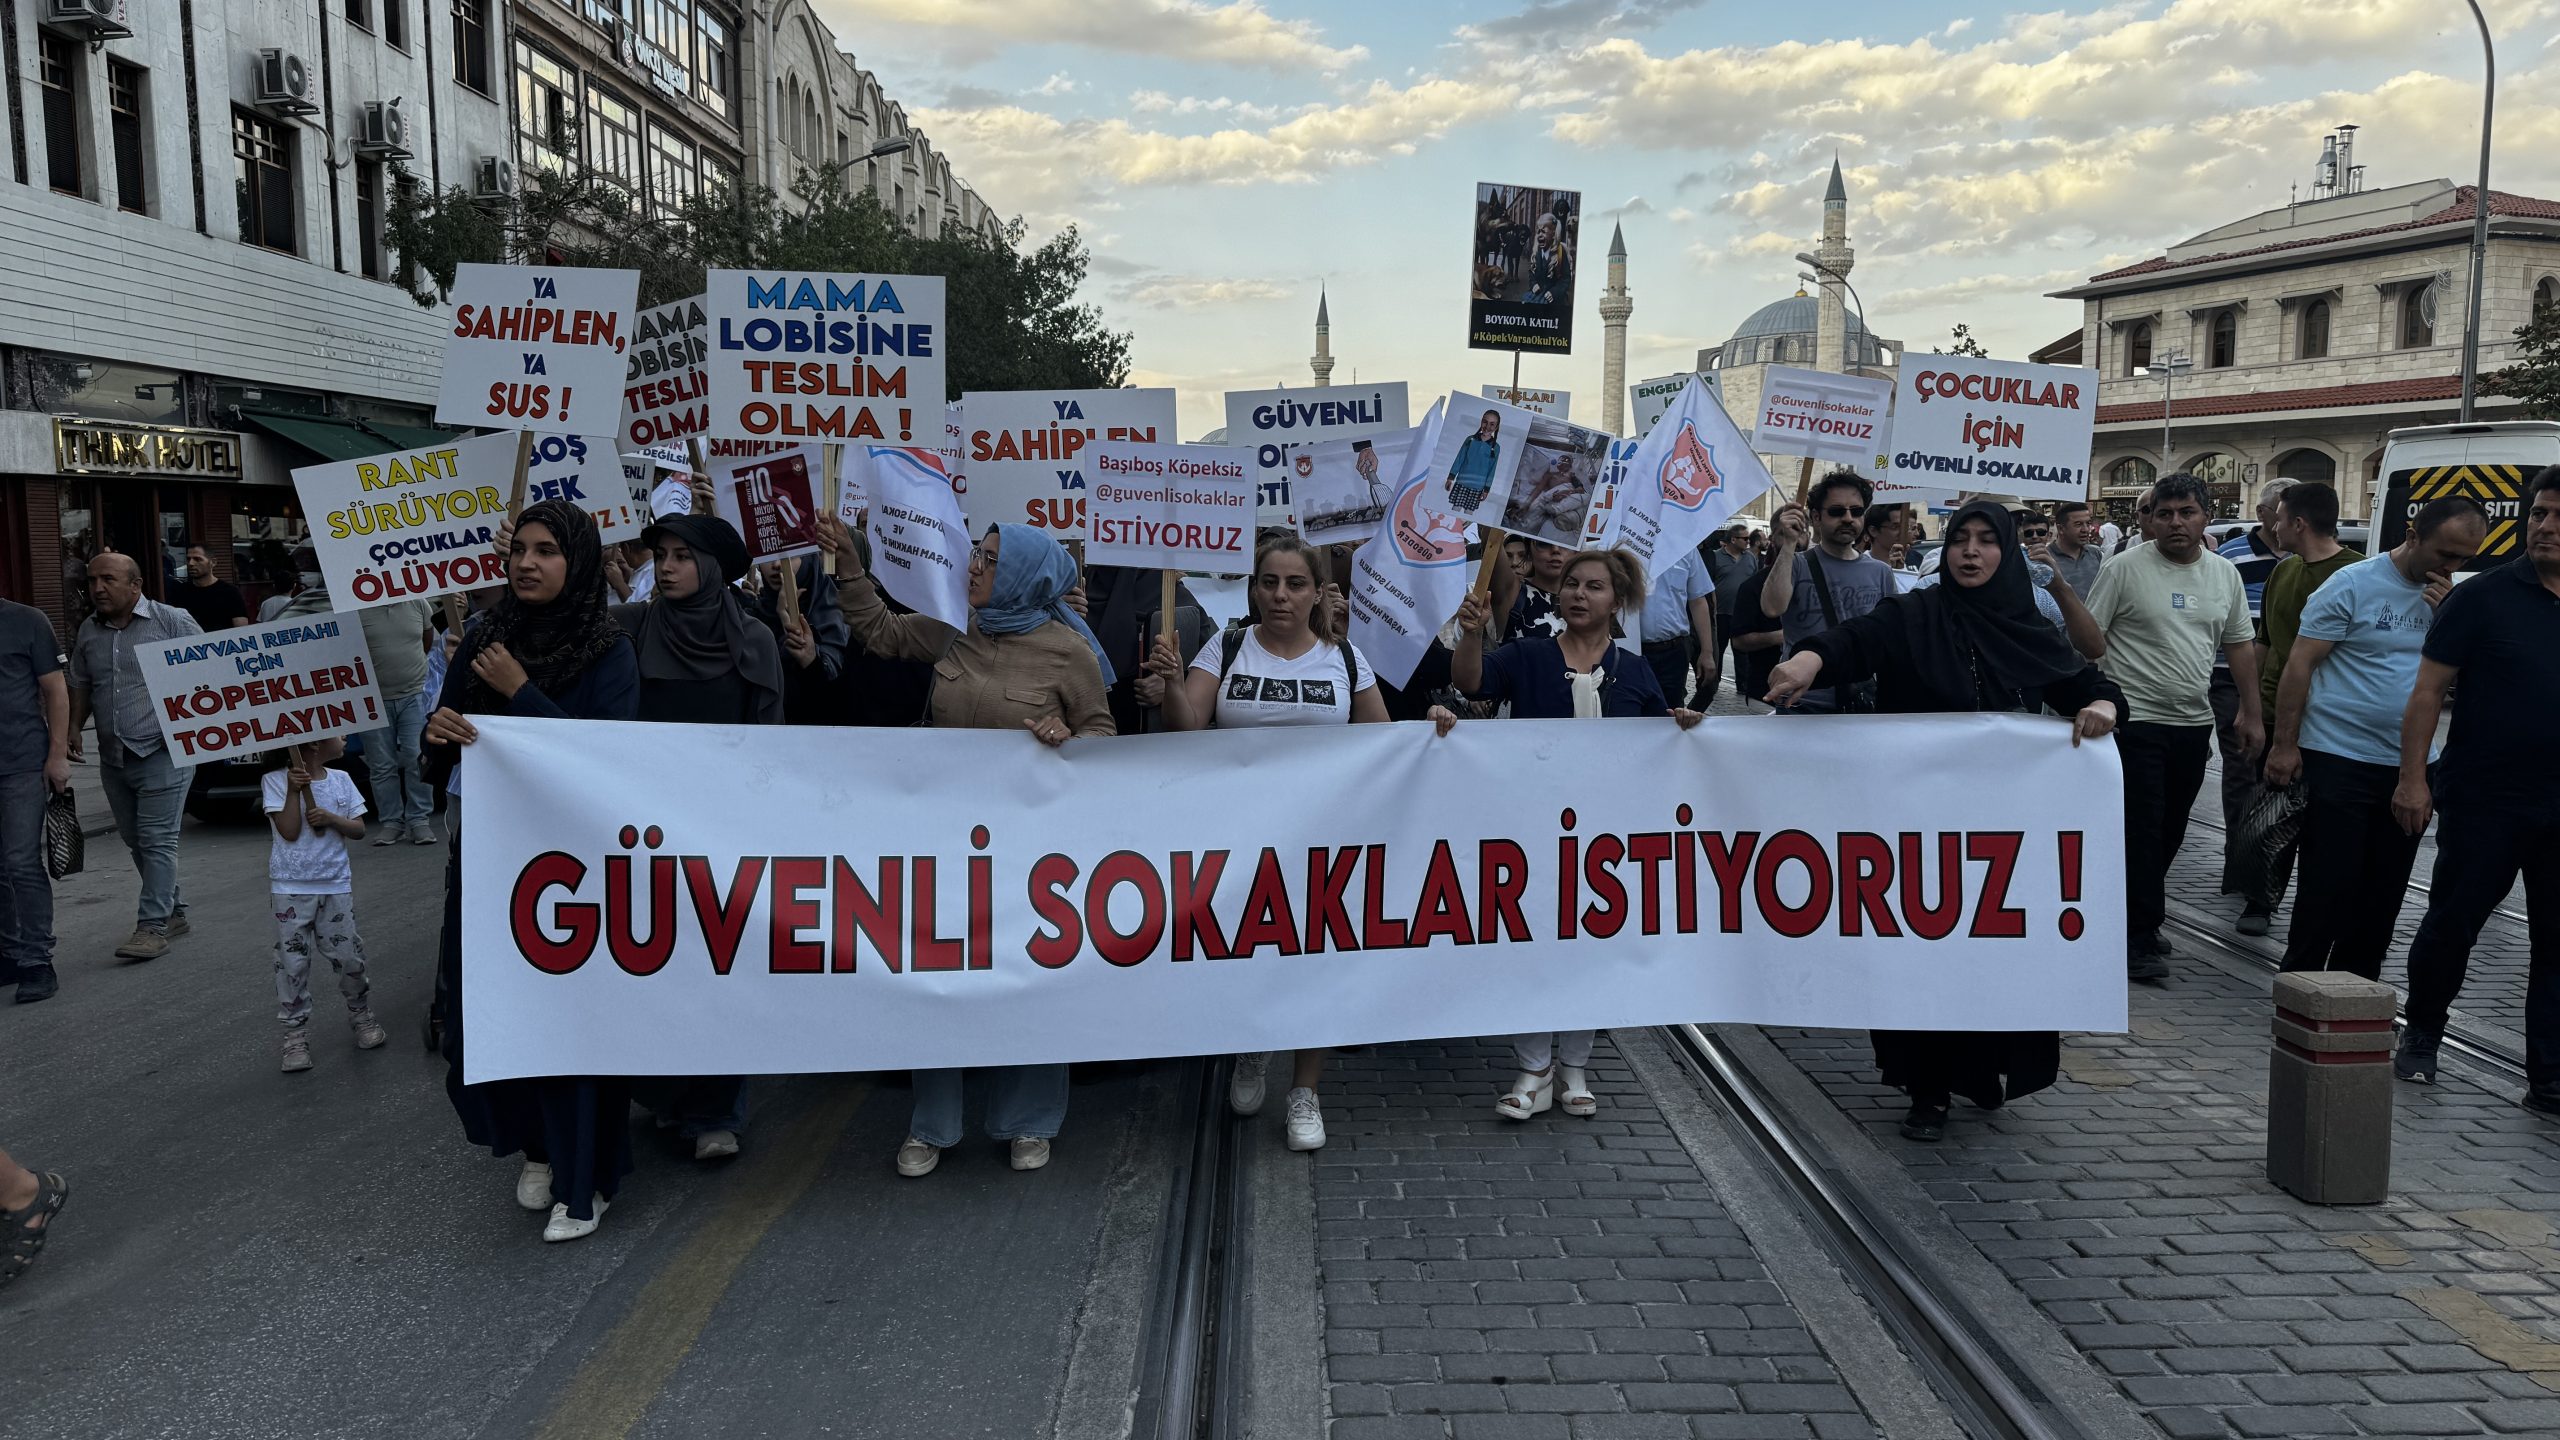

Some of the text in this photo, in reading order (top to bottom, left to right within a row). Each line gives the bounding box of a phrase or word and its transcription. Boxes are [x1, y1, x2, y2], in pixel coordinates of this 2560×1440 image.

[118, 0, 126, 21] VES
[533, 277, 557, 299] YA
[748, 276, 904, 313] MAMA
[454, 299, 626, 354] SAHİPLEN,
[631, 302, 708, 345] AMA
[720, 313, 932, 357] LOBİSİNE
[1485, 314, 1559, 330] BOYKOTA KATIL!
[523, 353, 547, 375] YA
[627, 333, 708, 381] OBİSİN
[743, 356, 906, 398] TESLİM
[1915, 370, 2080, 409] ÇOCUKLAR
[486, 382, 572, 422] SUS !
[740, 401, 912, 441] OLMA !
[1053, 400, 1084, 420] YA
[1252, 392, 1383, 430] GÜVENLİ
[1771, 394, 1875, 417] @Guvenlisokaklar
[1764, 407, 1873, 439] İSTİYORUZ
[1962, 412, 2024, 453] İÇİN
[63, 429, 239, 472] THINK HOTEL
[356, 449, 459, 491] RANT
[1099, 454, 1243, 478] Başıboş Köpeksiz
[1895, 451, 1973, 475] GÜVENLİ
[1976, 460, 2072, 484] SOKAKLAR
[2076, 469, 2083, 485] !
[1056, 470, 1086, 490] YA
[1096, 483, 1246, 507] @guvenlisokaklar
[2482, 501, 2520, 520] ŞITI
[369, 526, 494, 566] ÇOCUKLAR
[1093, 512, 1242, 552] İSTİYORUZ
[164, 621, 340, 666] HAYVAN REFAHI
[235, 653, 284, 677] İÇİN
[163, 656, 369, 722] KÖPEKLERİ
[174, 697, 379, 756] TOPLAYIN !
[508, 802, 2085, 977] GÜVENLİ SOKAKLAR İSTİYORUZ !
